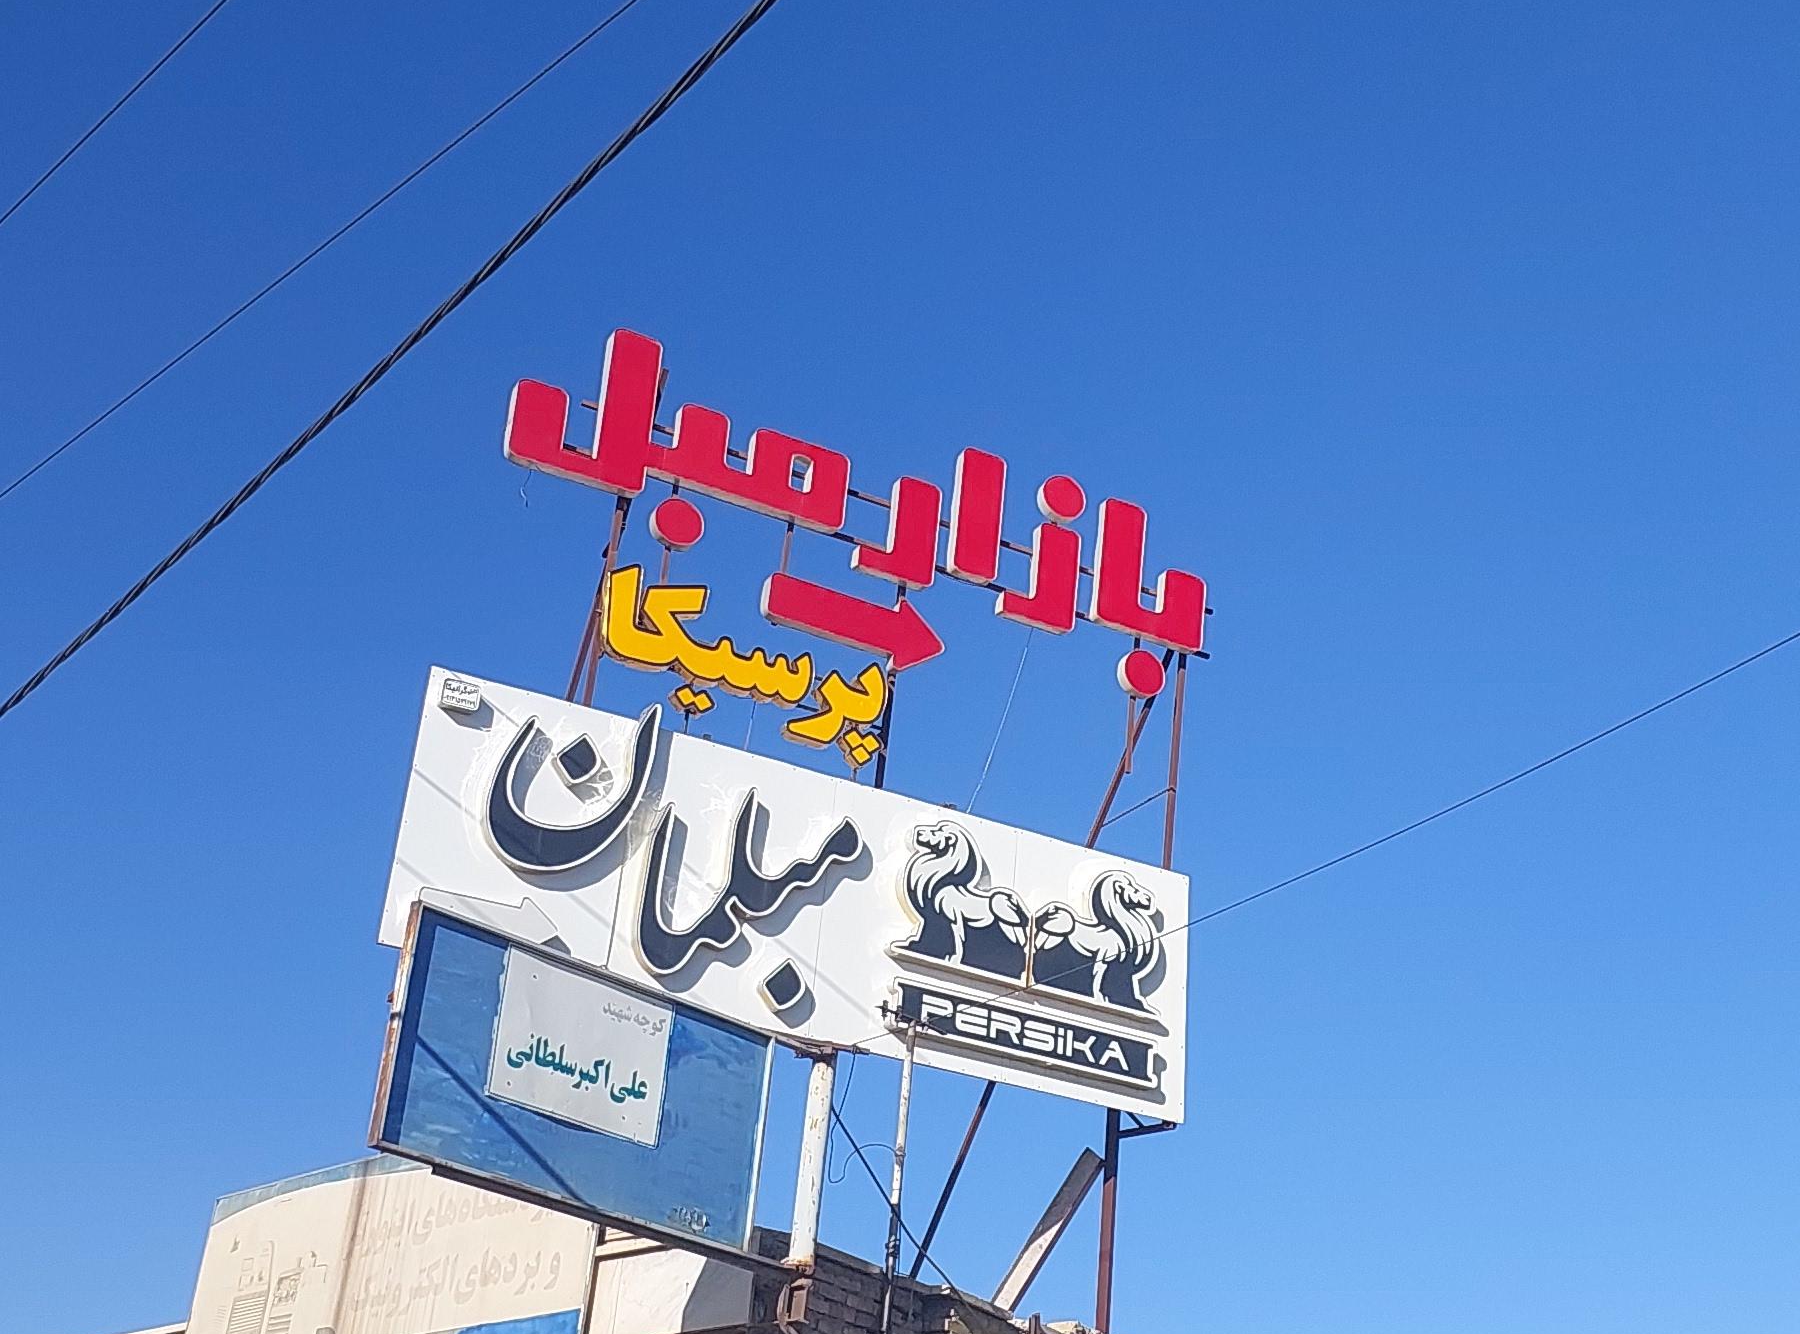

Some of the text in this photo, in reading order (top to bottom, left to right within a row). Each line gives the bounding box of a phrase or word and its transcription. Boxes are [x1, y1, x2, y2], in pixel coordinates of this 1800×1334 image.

[504, 328, 1205, 698] بازار مبل
[600, 564, 887, 768] پرسیکا
[484, 704, 864, 1016] مبلمان
[506, 1033, 648, 1104] علی اکبر سلطانی
[602, 1002, 666, 1036] کوچه شهید
